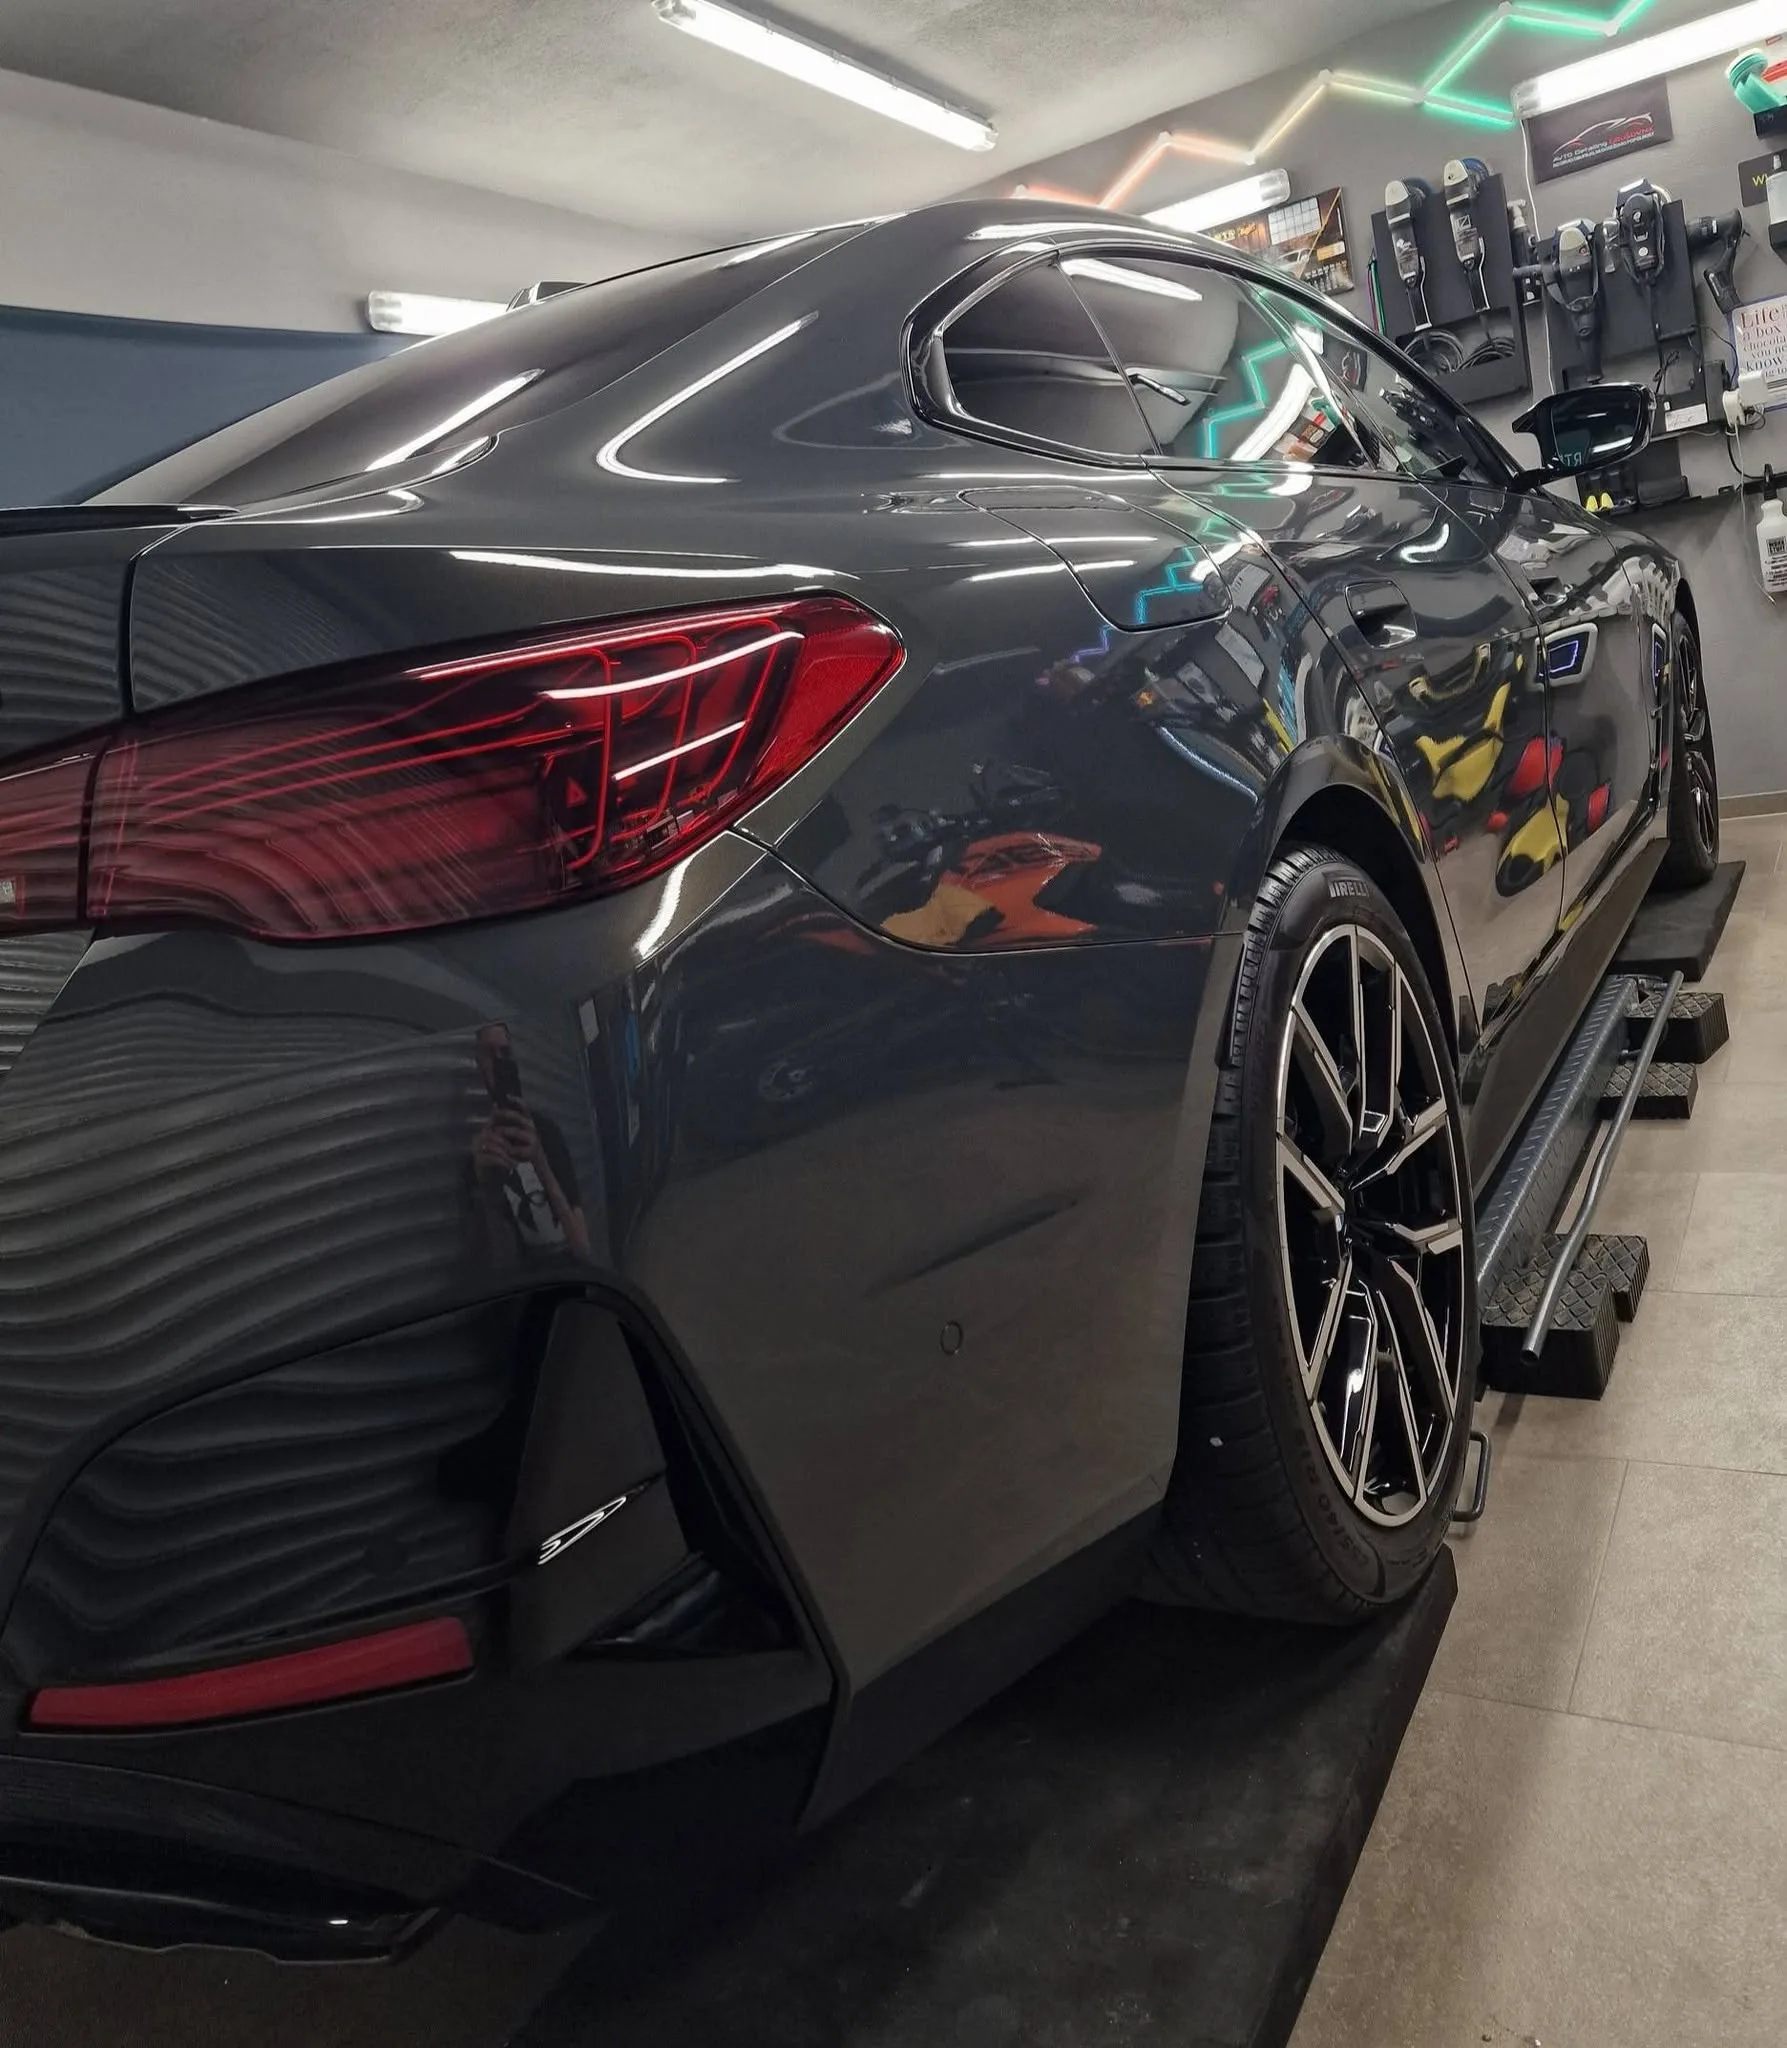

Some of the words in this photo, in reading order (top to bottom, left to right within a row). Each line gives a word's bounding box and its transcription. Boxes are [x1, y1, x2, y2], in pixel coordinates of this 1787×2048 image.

[1741, 308, 1779, 328] Life
[1756, 325, 1782, 337] box
[1746, 356, 1783, 372] know
